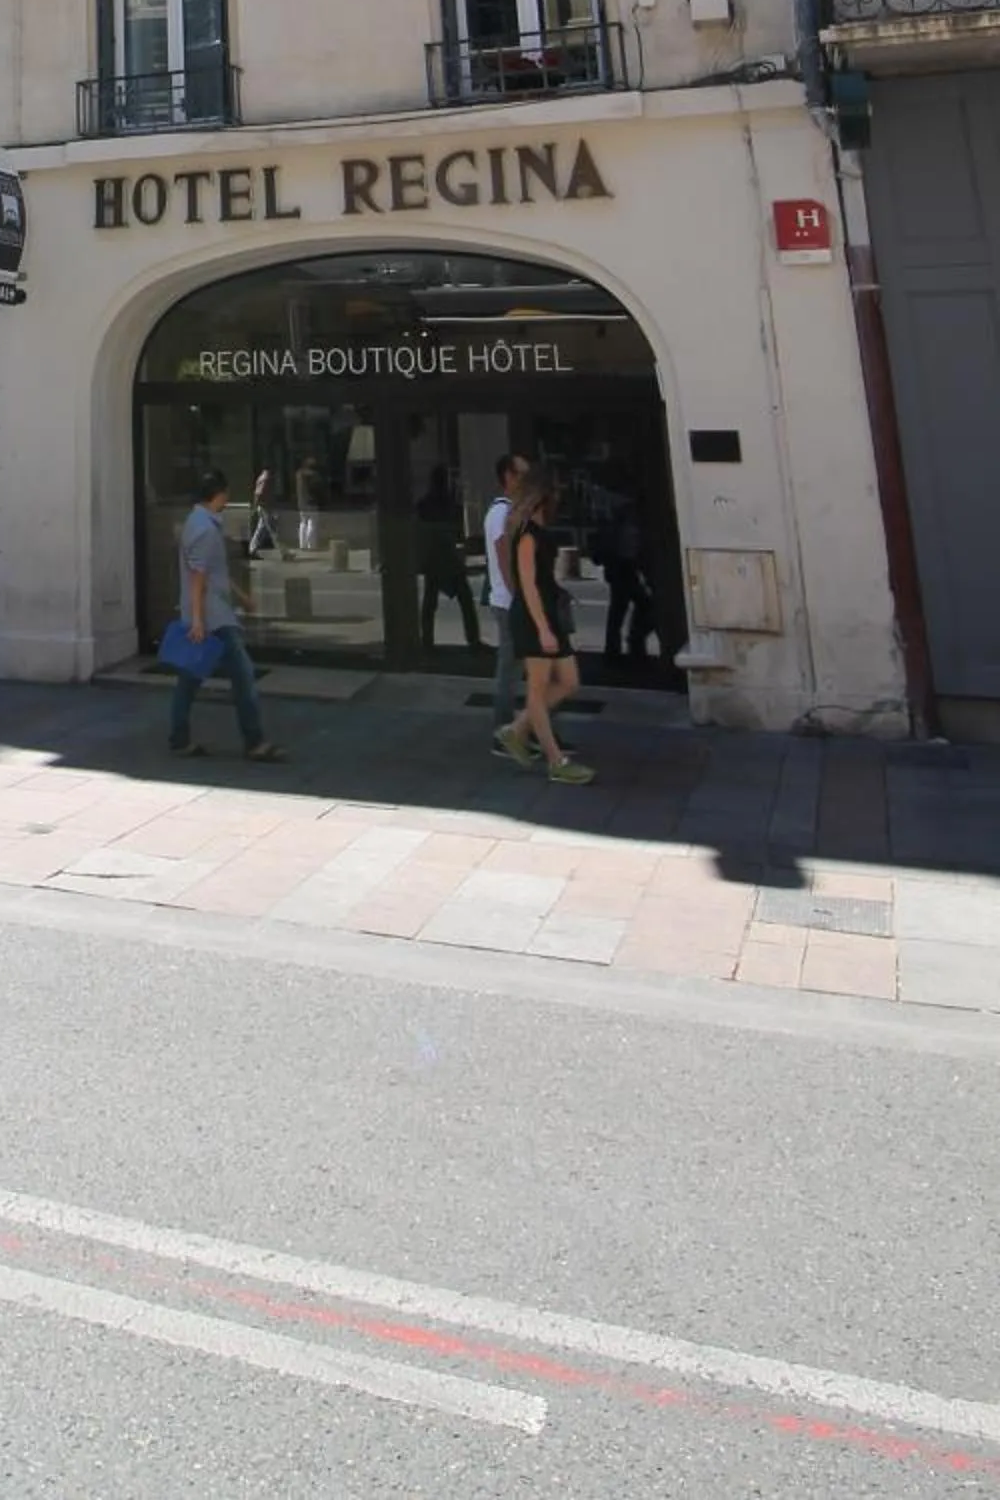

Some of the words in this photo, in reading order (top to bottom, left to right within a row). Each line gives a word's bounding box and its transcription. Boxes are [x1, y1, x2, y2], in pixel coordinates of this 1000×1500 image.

[93, 165, 301, 229] HOTEL
[340, 138, 615, 215] REGINA
[796, 209, 819, 228] H
[199, 350, 298, 377] REGINA
[308, 345, 457, 380] BOUTIQUE
[467, 339, 574, 373] HÔTEL
